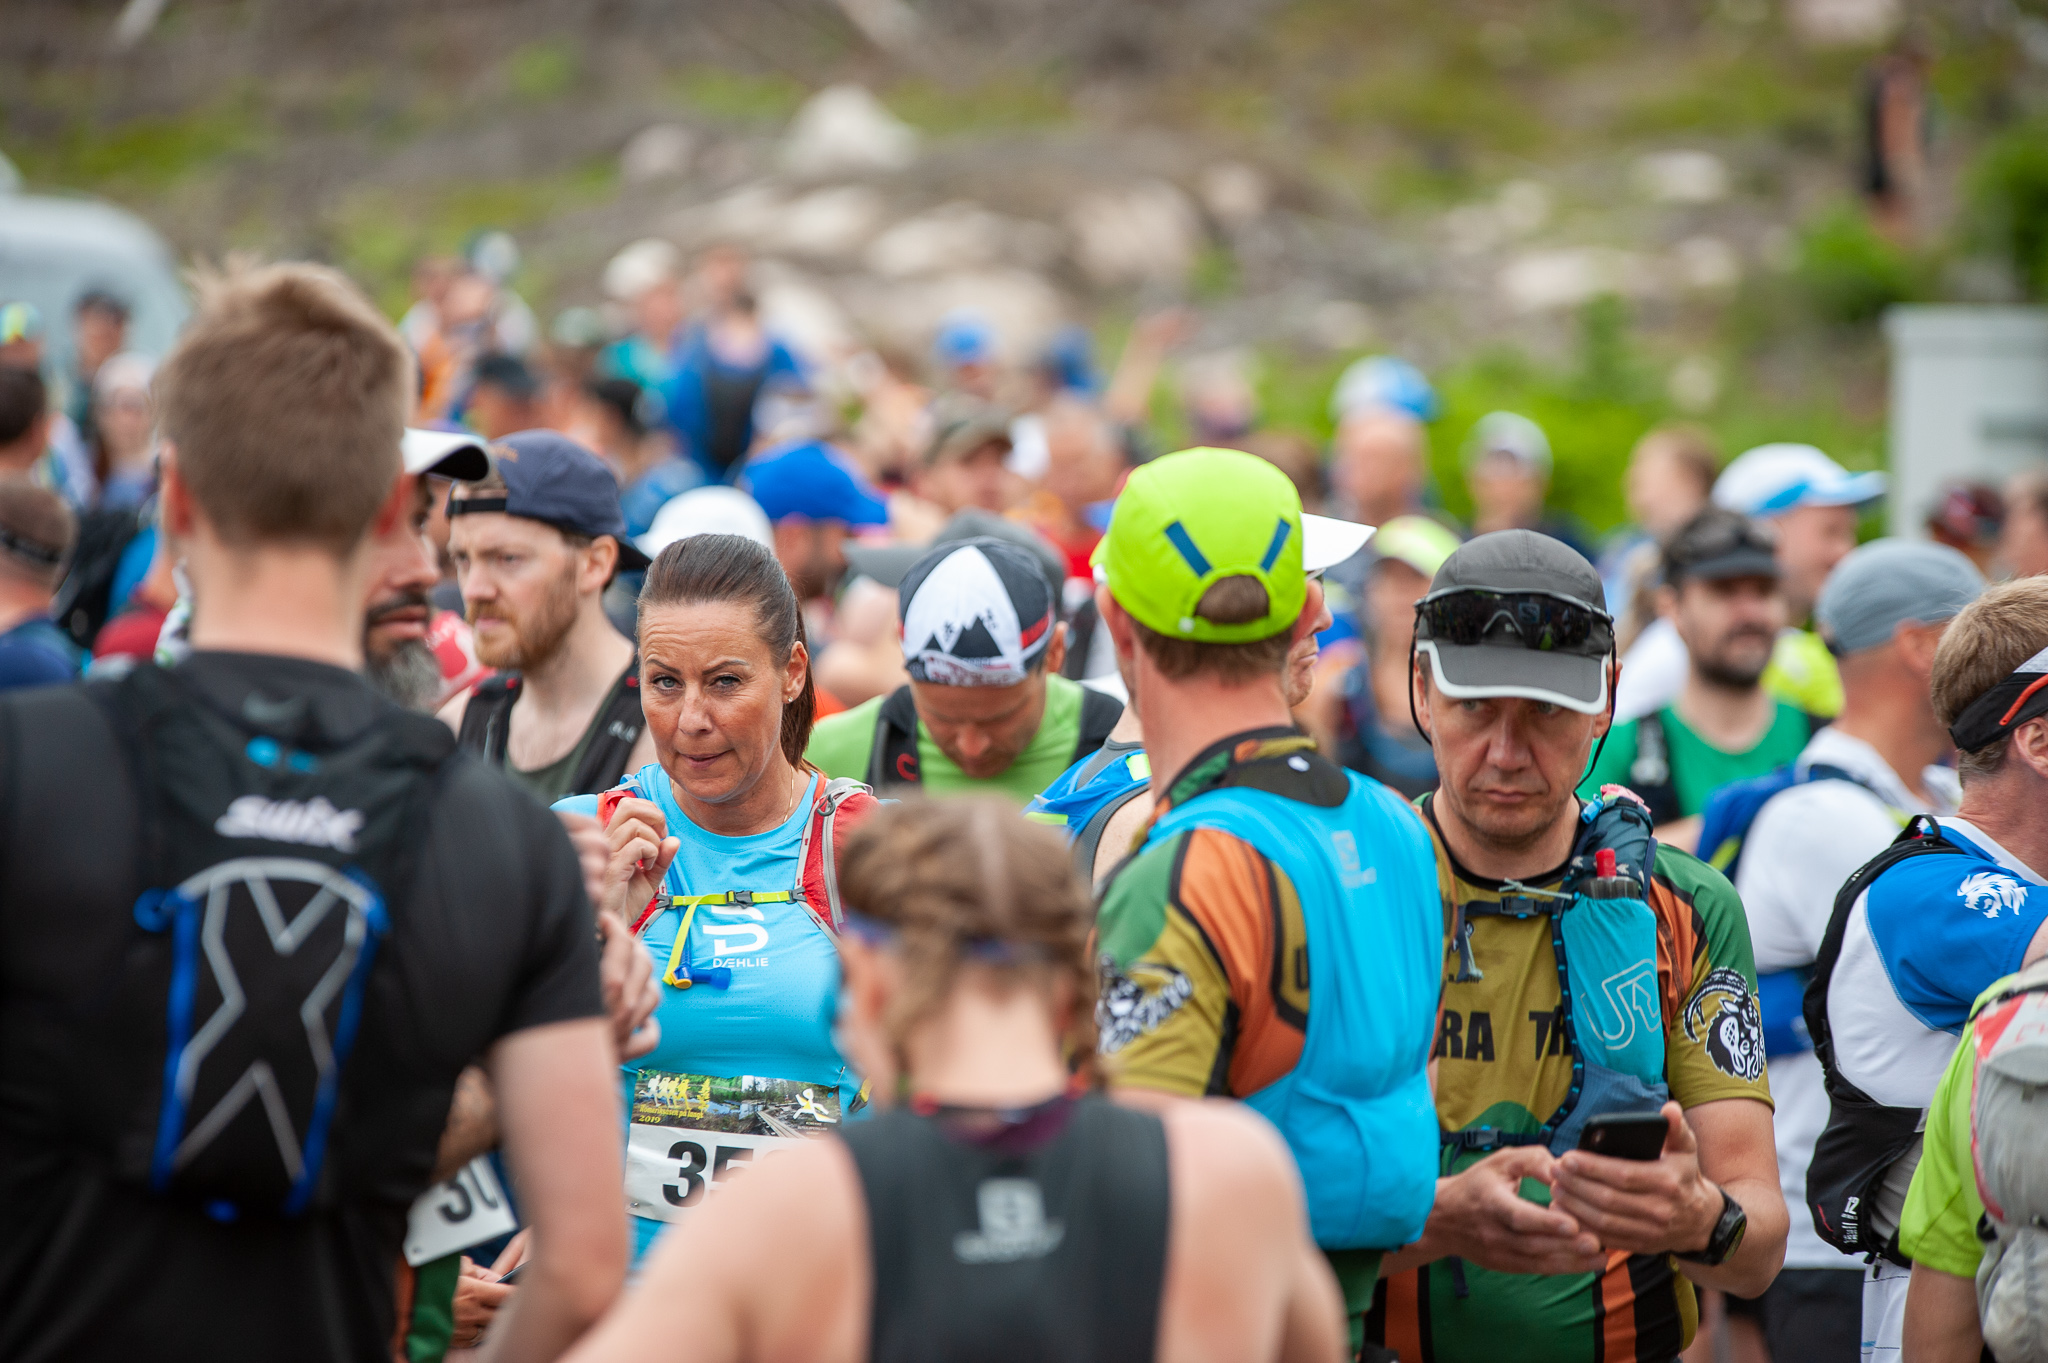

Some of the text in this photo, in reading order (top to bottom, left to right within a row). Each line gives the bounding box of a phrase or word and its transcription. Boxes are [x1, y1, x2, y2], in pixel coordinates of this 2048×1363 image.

[712, 957, 769, 968] DÆHLIE
[638, 1114, 662, 1124] 2019
[662, 1140, 775, 1209] 35
